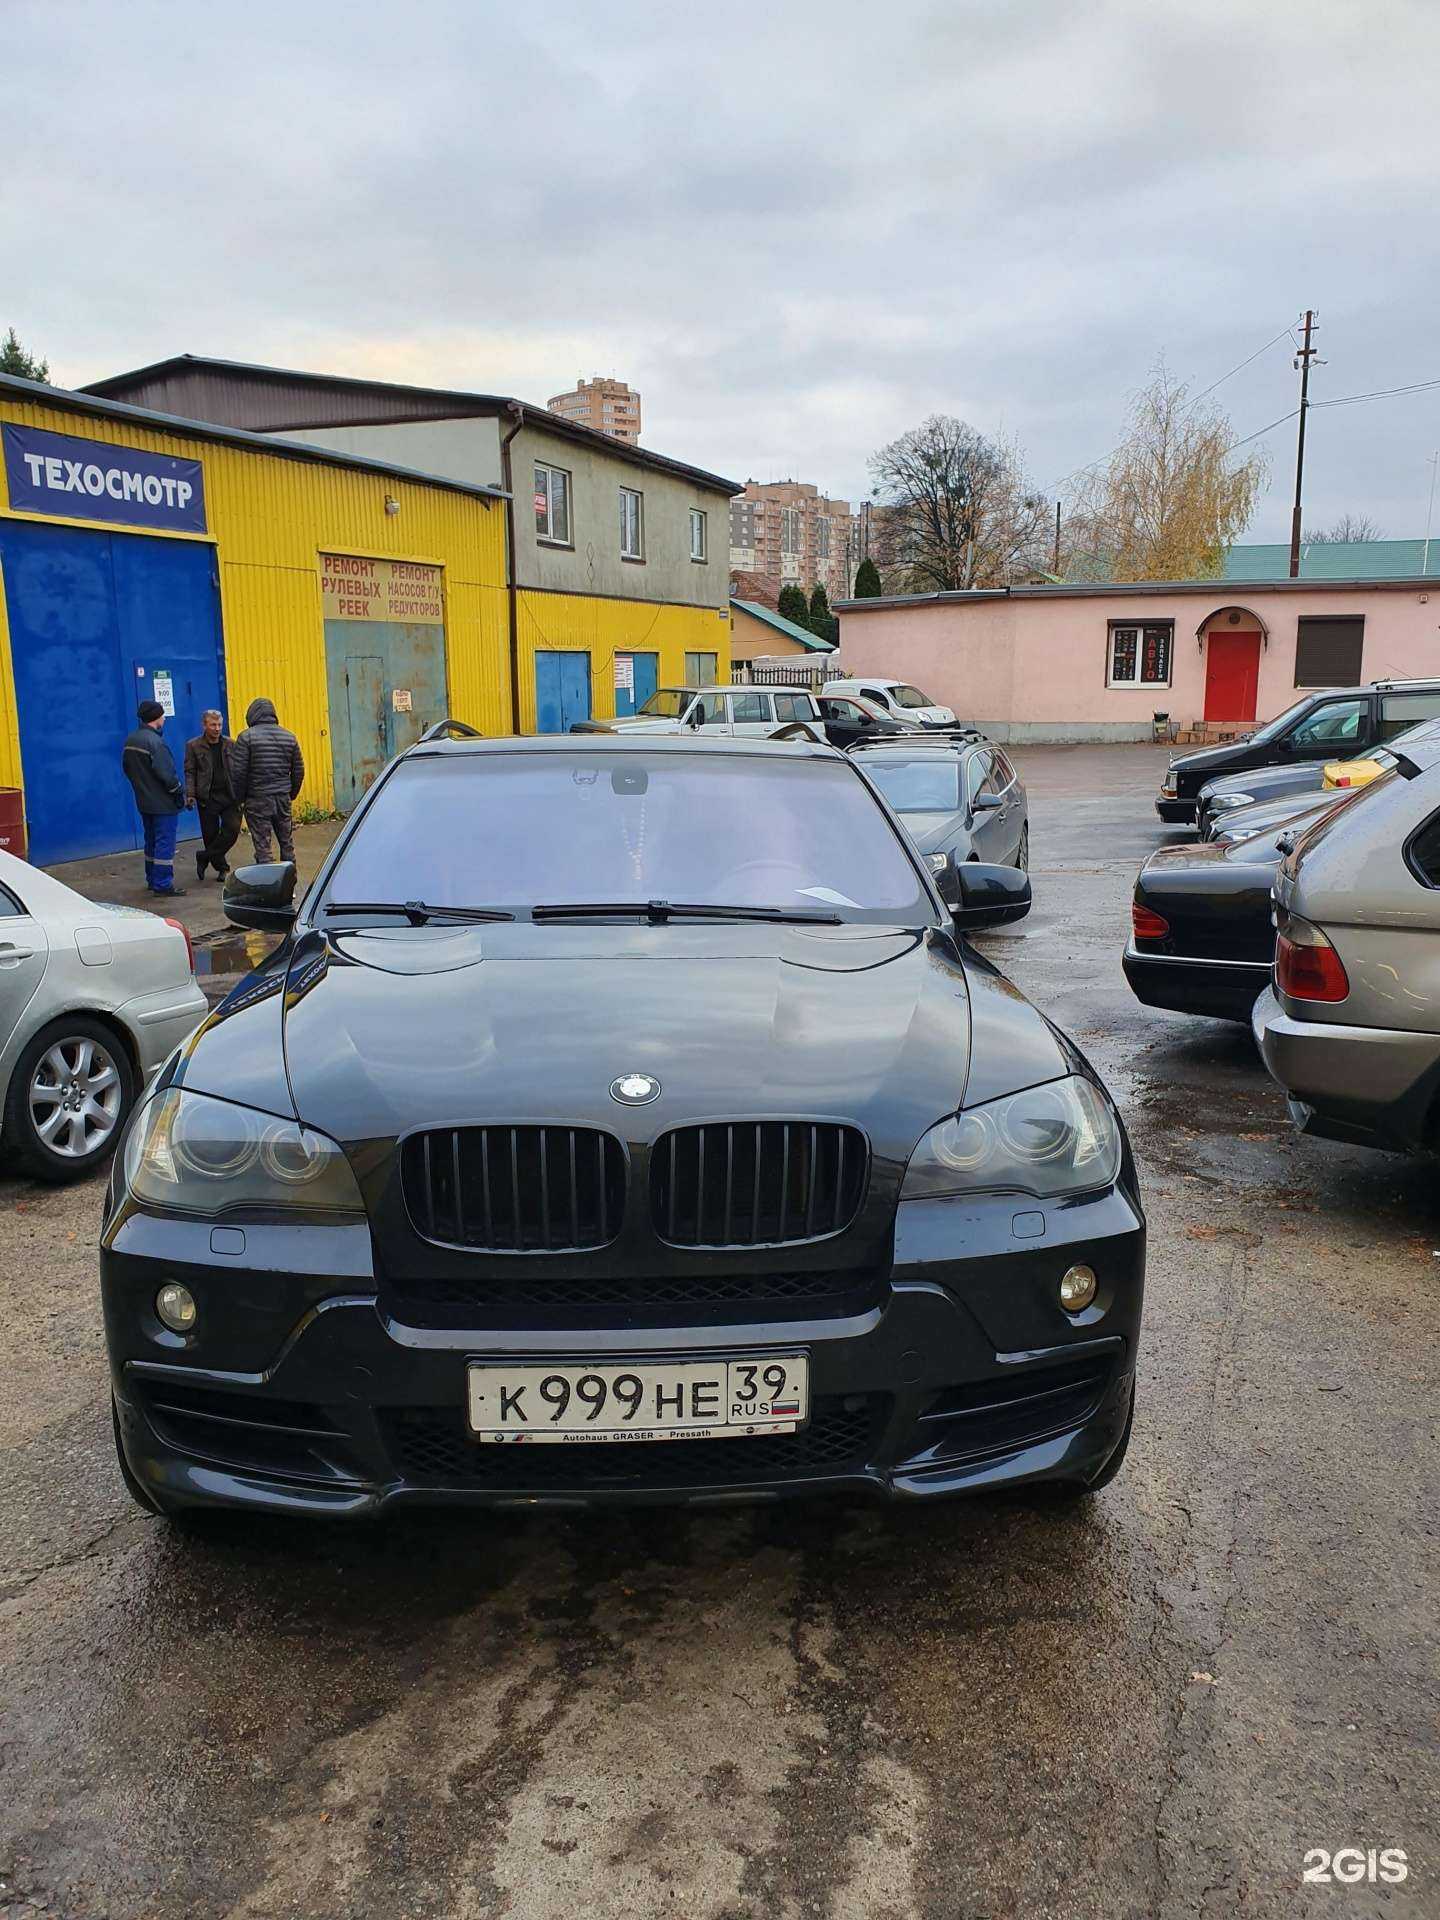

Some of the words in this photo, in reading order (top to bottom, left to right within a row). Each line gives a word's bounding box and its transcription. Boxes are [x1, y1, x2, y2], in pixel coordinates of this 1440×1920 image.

[24, 453, 193, 508] ТЕХОСМОТР
[324, 557, 376, 577] РЕМОНТ
[391, 564, 436, 582] РЕМОНТ
[322, 577, 381, 598] РУЛЕВЫХ
[387, 581, 426, 598] НАСОСОВ
[339, 599, 370, 616] РЕЕК
[388, 599, 440, 617] РЕДУКТОРОВ
[1146, 639, 1156, 679] АВТО
[736, 1365, 787, 1401] 39
[731, 1403, 770, 1417] RUS
[562, 1433, 608, 1442] Autohaus
[612, 1432, 654, 1440] GRASER
[669, 1429, 711, 1438] Pressath
